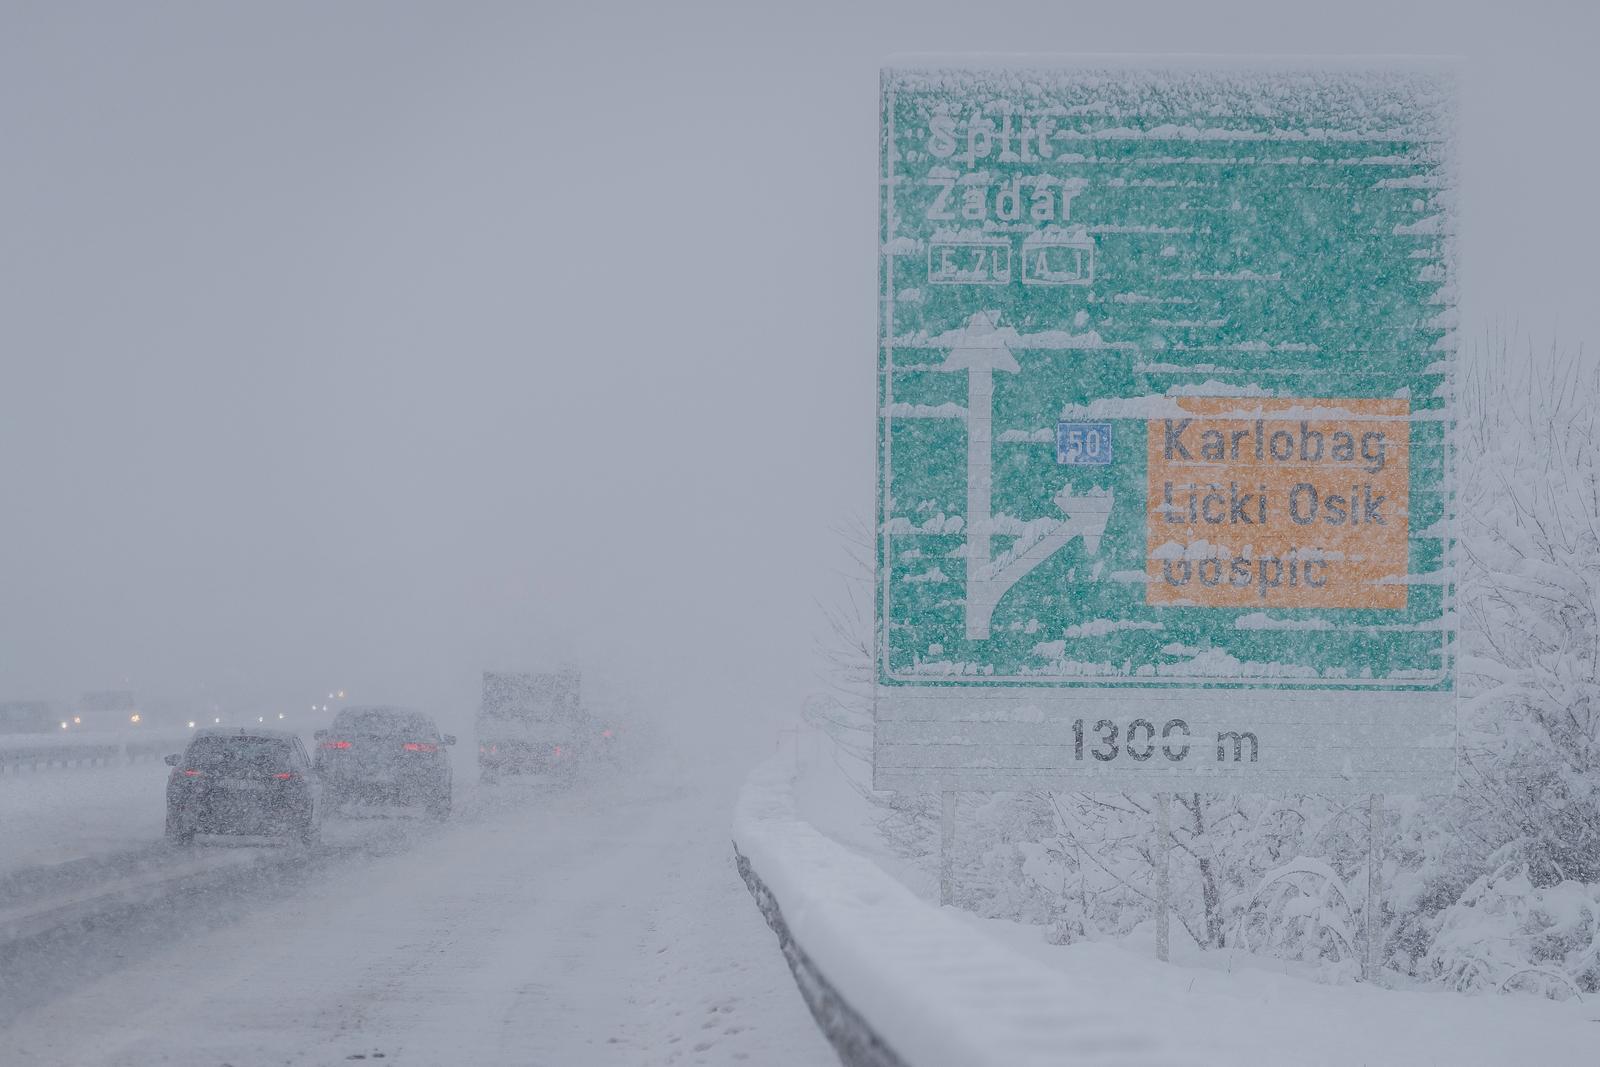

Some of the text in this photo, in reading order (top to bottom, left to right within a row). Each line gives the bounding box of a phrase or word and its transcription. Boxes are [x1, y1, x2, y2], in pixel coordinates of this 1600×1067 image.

[928, 113, 1056, 168] Split
[927, 174, 1088, 221] Zadar
[1036, 251, 1050, 274] A
[1069, 430, 1100, 457] 50
[1164, 418, 1386, 473] Karlobag
[1289, 482, 1388, 526] Osik
[1072, 718, 1259, 762] 1300 m
